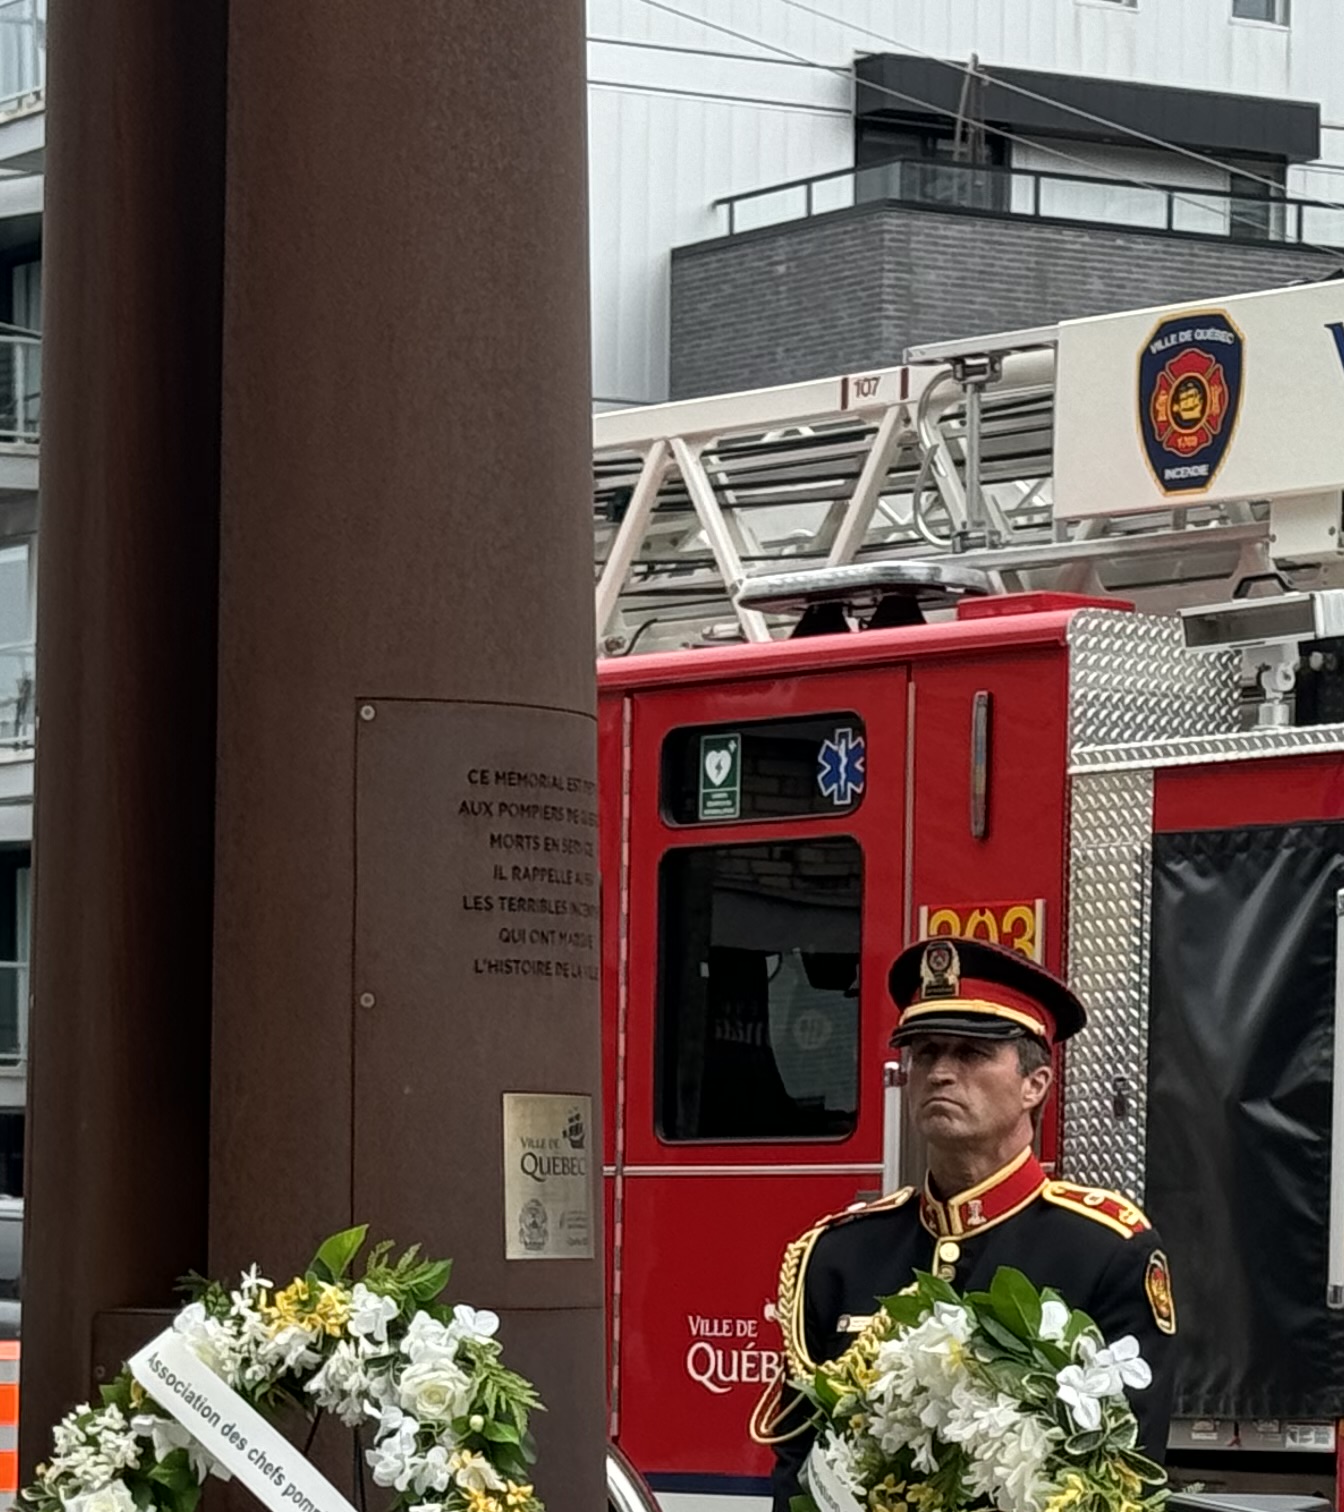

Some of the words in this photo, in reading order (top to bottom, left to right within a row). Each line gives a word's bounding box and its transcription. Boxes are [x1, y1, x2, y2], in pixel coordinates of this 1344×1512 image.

[1150, 333, 1177, 354] VILLE
[1179, 330, 1193, 343] DE
[467, 769, 490, 786] CE
[458, 799, 494, 817] AUX
[489, 832, 541, 851] MORTS
[493, 863, 508, 881] IL
[462, 894, 494, 912] LES
[498, 926, 526, 945] QUI
[688, 1315, 733, 1336] VILLE
[736, 1319, 758, 1337] DE
[147, 1352, 222, 1429] Association
[220, 1420, 248, 1453] des
[246, 1445, 287, 1489] chefs
